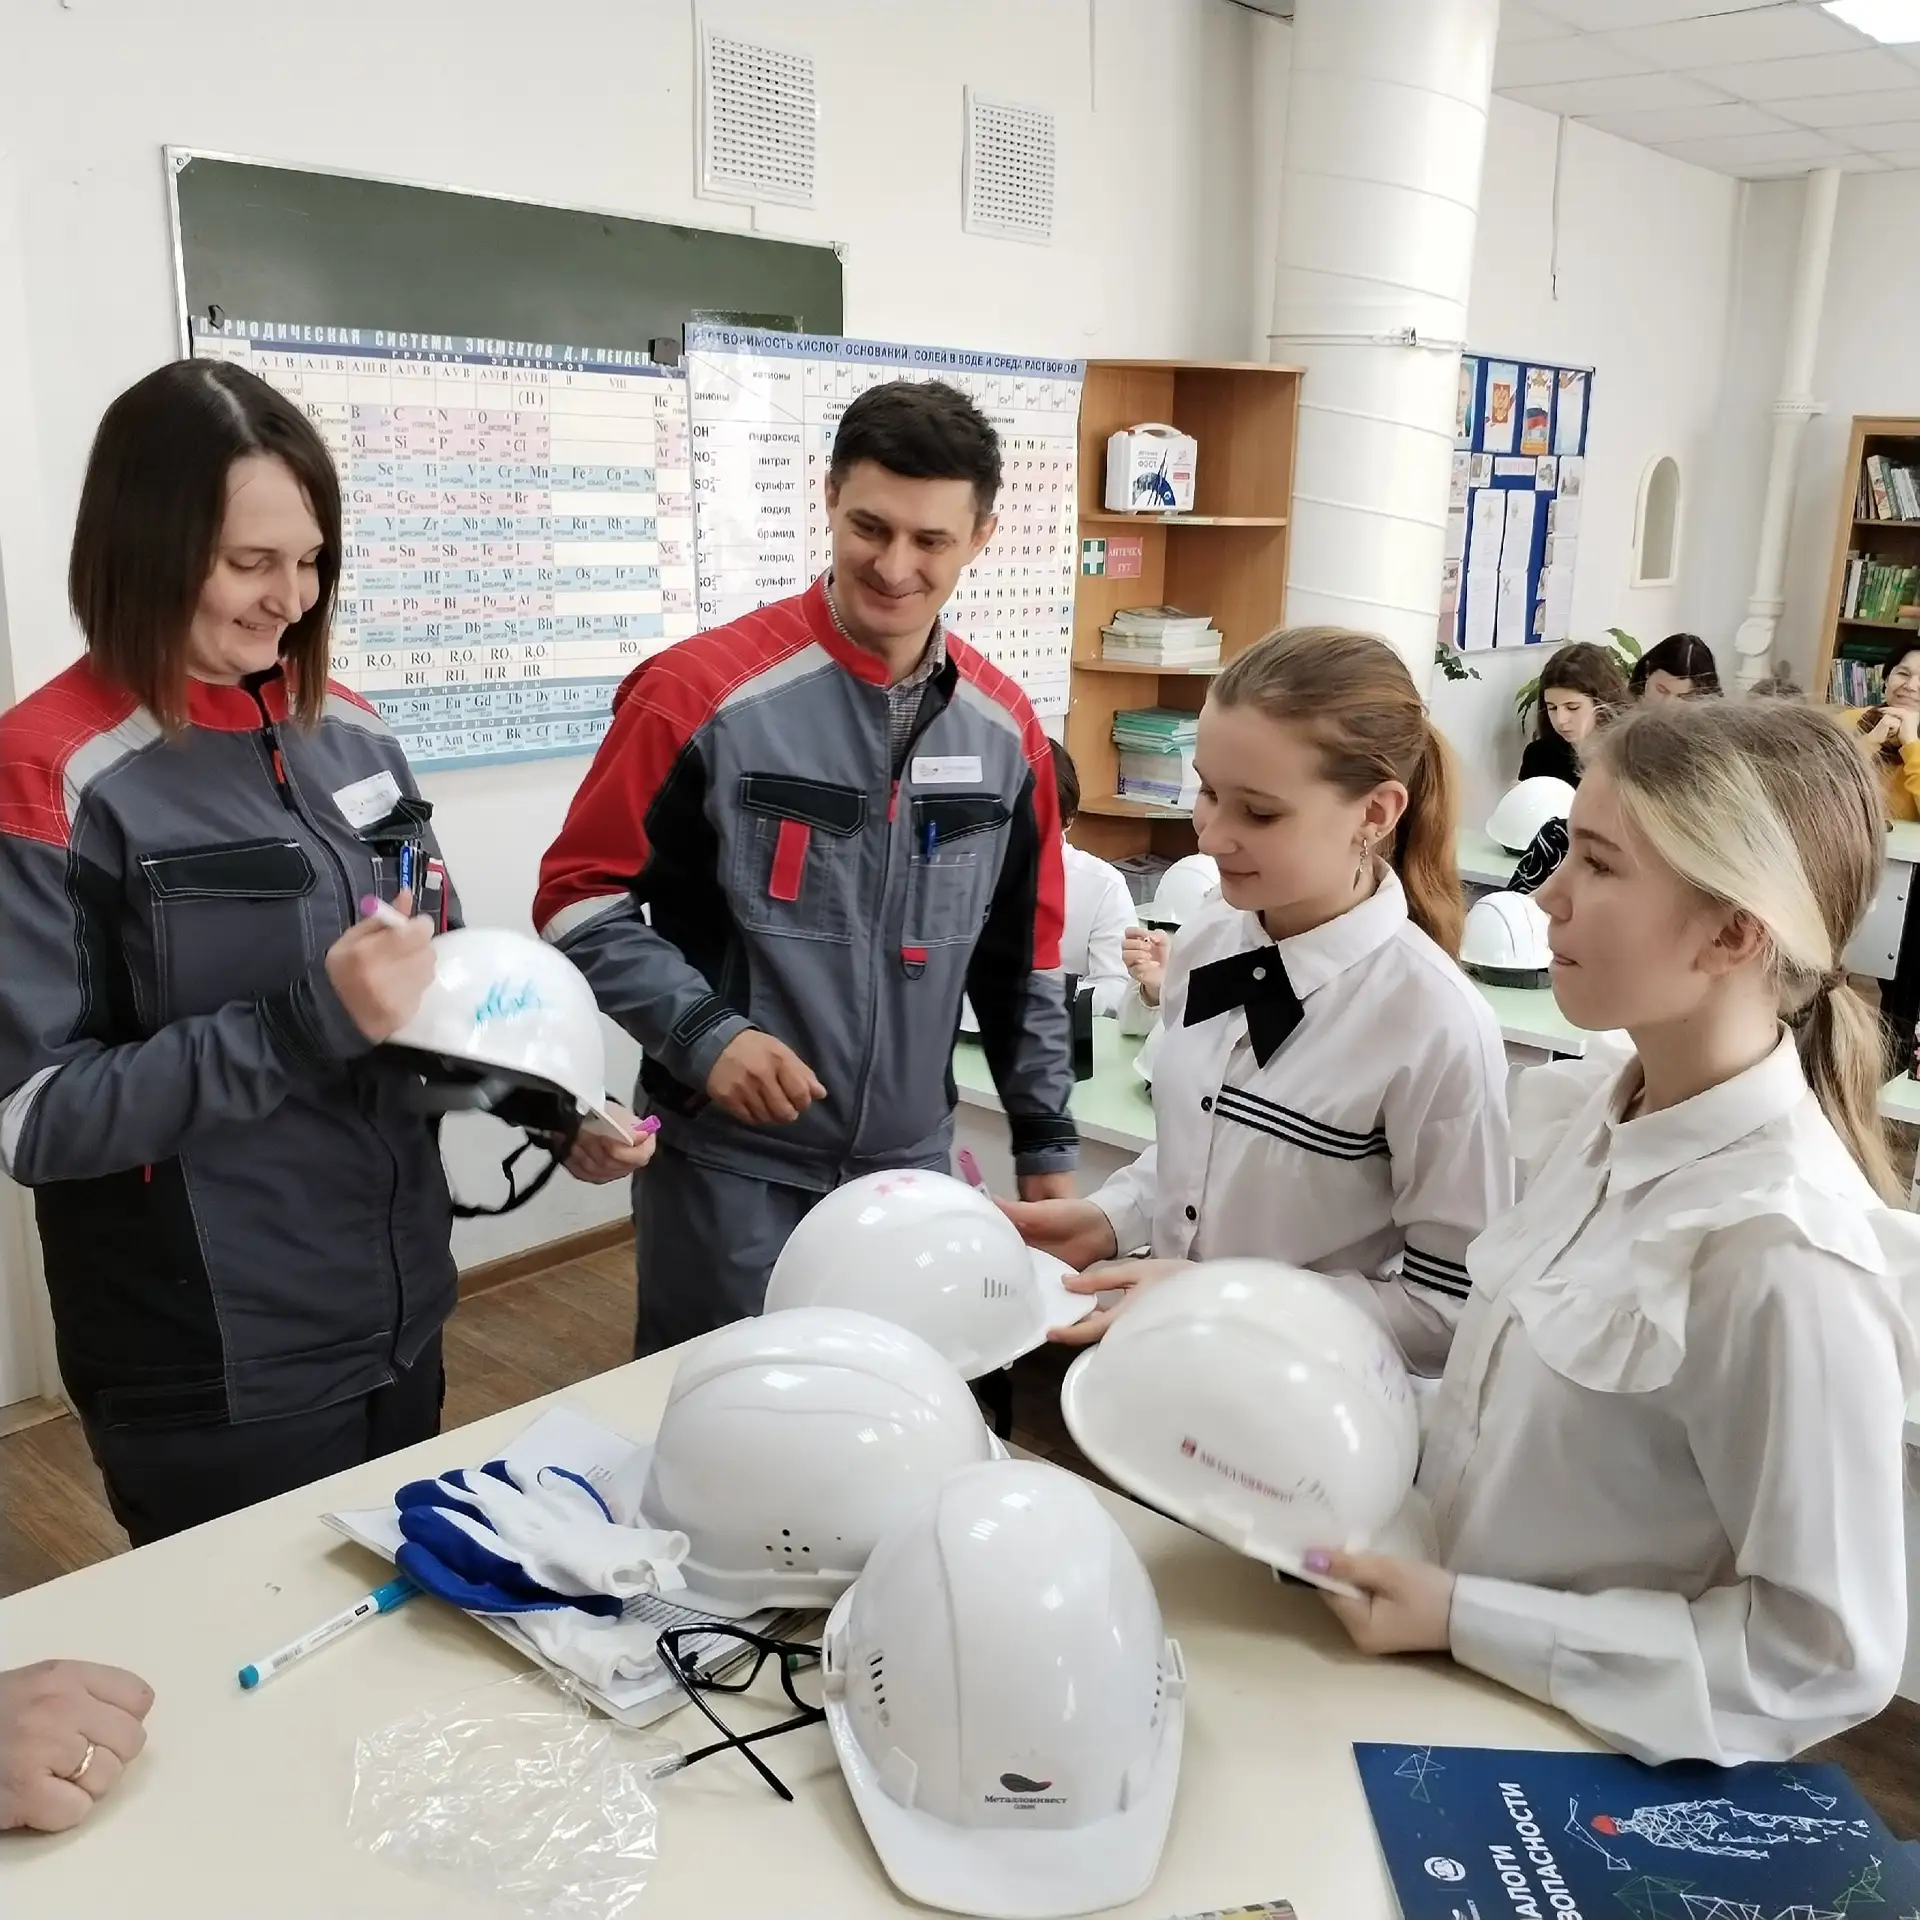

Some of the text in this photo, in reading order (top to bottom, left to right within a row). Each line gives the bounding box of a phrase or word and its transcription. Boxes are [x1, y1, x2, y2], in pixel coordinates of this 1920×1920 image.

[375, 330, 453, 350] СИСТЕМА
[466, 337, 553, 358] ЭЛЕМЕНТОВ
[391, 351, 463, 363] ГРУППЫ
[796, 340, 842, 356] КИСЛОТ,
[845, 343, 911, 363] ОСНОВАНИЙ,
[914, 350, 947, 363] СОЛЕЙ
[949, 353, 956, 363] В
[958, 354, 983, 367] ВОДЕ
[986, 356, 992, 368] И
[994, 357, 1022, 371] СРЕДА
[1025, 359, 1077, 374] РАСТВОРОВ
[755, 480, 796, 492] сульфат
[1488, 1845, 1543, 1920] АЛОГИ
